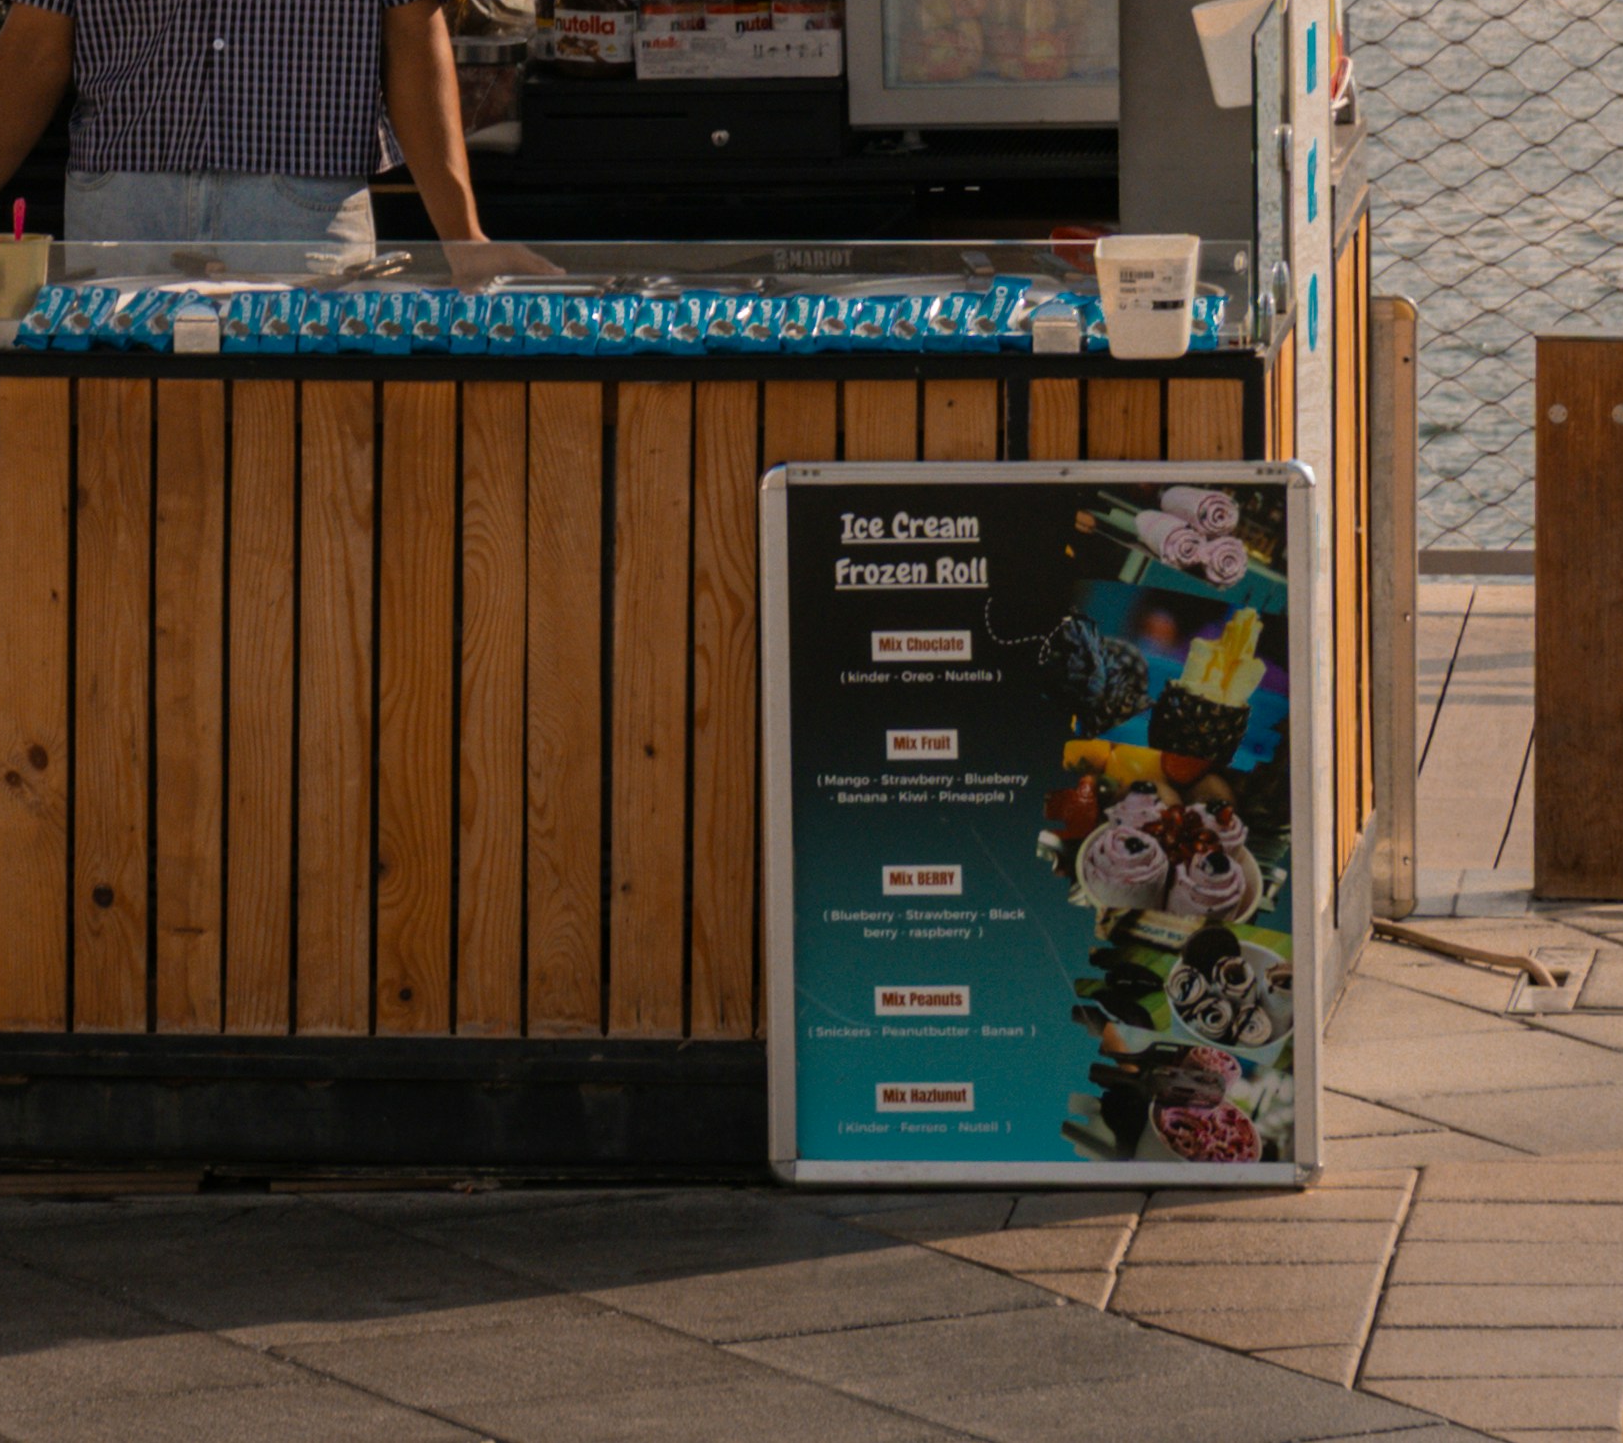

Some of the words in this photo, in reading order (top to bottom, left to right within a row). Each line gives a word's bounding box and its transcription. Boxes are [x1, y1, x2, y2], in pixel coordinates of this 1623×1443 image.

[554, 15, 616, 35] nutella
[788, 249, 852, 268] MARIOT
[840, 512, 885, 538] Ice
[892, 510, 980, 538] Cream
[834, 557, 928, 585] Frozen
[936, 555, 988, 584] Roll
[878, 637, 902, 653] Mix
[905, 636, 965, 652] Choclate
[848, 670, 891, 684] kinder
[901, 670, 935, 682] Oreo
[945, 669, 993, 682] Nutella
[893, 735, 916, 750] Mix
[920, 734, 951, 750] Fruit
[825, 774, 870, 788] Mango
[880, 773, 954, 787] Strawberry
[963, 772, 1029, 787] Blueberry
[837, 791, 888, 803] Banana
[898, 790, 928, 802] Kiwi
[938, 790, 1006, 805] Pineapple
[889, 871, 913, 886] Mix
[917, 870, 955, 885] BERRY
[830, 909, 894, 923] Blueberry
[905, 909, 978, 923] Strawberry
[988, 908, 1026, 920] Black
[863, 927, 898, 941] berry
[908, 927, 972, 941] raspberry
[881, 992, 905, 1007] Mix
[909, 991, 962, 1007] Peanuts
[815, 1026, 872, 1038] Snickers
[882, 1025, 970, 1037] Peanutbutter
[882, 1088, 907, 1103] Mix
